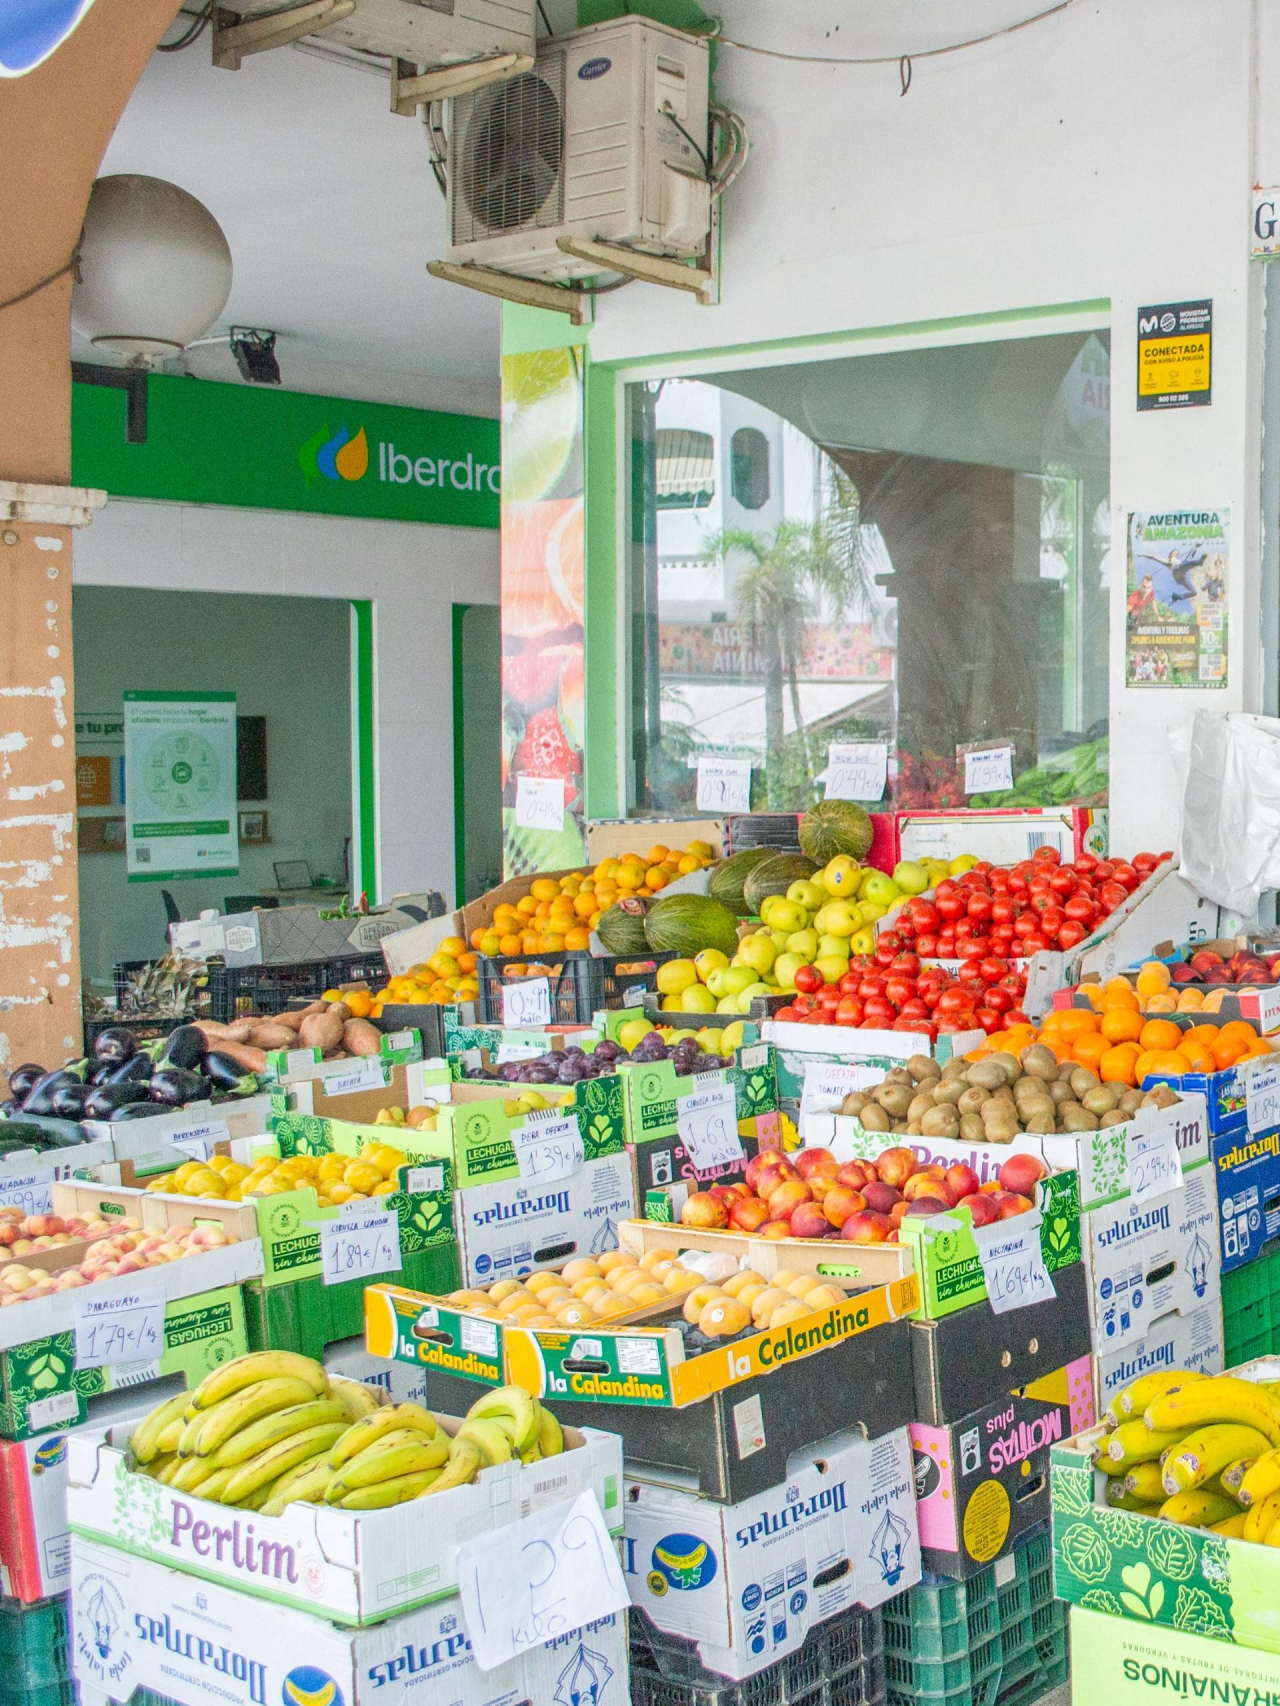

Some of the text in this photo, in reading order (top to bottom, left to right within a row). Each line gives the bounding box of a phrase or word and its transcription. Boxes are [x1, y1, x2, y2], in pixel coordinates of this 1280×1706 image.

[582, 61, 608, 76] Carrier
[1144, 344, 1205, 358] CONECTADA
[1147, 512, 1220, 526] AVENTURA
[1143, 525, 1224, 541] AMAZONIA
[473, 1190, 572, 1227] Doramas
[1098, 1204, 1171, 1249] Doramas
[87, 1296, 140, 1313] PARAGUAYO
[170, 1320, 232, 1346] LECHUGAS
[727, 1307, 870, 1380] la Calandina
[400, 1335, 499, 1381] la Calandina
[1105, 1340, 1176, 1390] Doramas
[549, 1371, 664, 1400] la Calandina
[986, 1403, 1015, 1433] plus
[736, 1481, 848, 1549] Doramas
[171, 1499, 299, 1584] Perlim
[135, 1612, 268, 1706] Doramas
[1122, 1641, 1168, 1660] VERDURAS
[1181, 1656, 1215, 1670] FRUTAS
[404, 1665, 451, 1688] CERTIFICADA
[1217, 1663, 1230, 1674] DE
[1234, 1667, 1280, 1684] INTEGRAL
